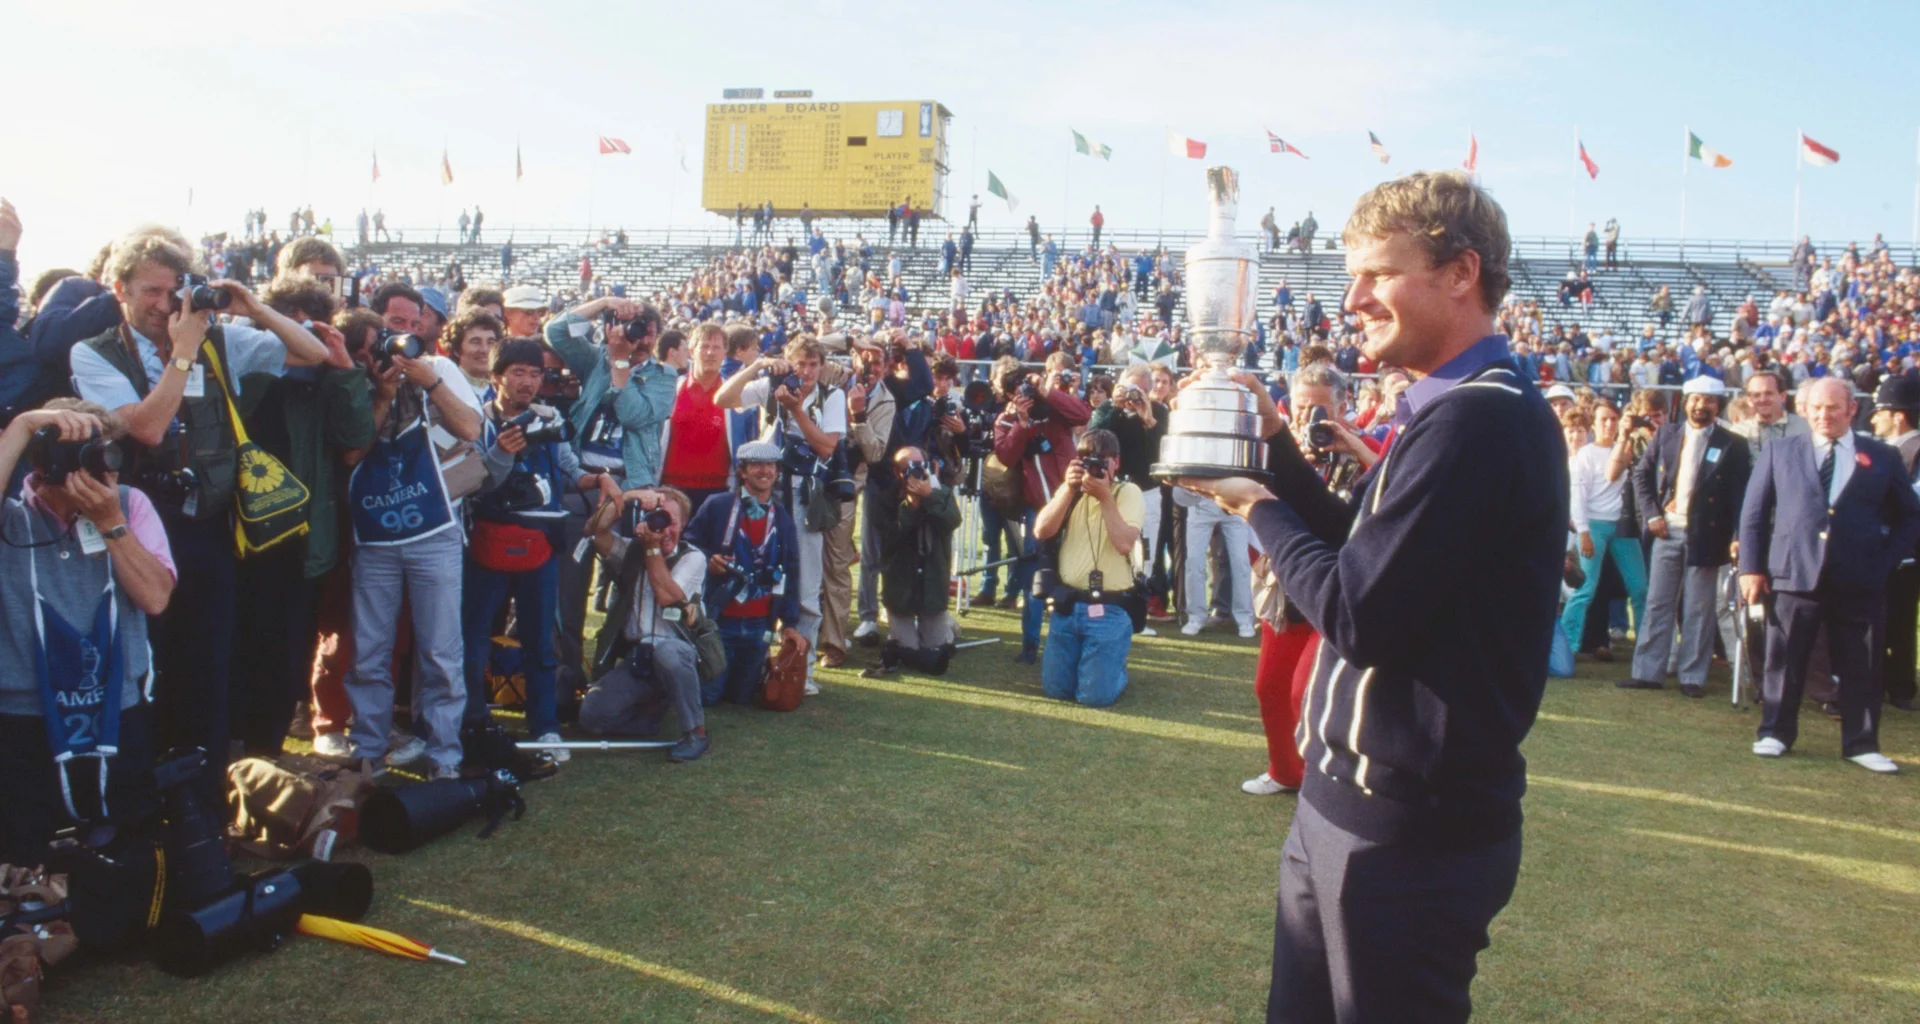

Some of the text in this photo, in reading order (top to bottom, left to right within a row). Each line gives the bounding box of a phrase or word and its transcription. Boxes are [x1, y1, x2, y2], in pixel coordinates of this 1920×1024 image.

[712, 102, 840, 114] LEADER BOARD
[873, 151, 910, 160] PLAYER
[362, 481, 429, 510] CAMERA
[381, 503, 424, 533] 96
